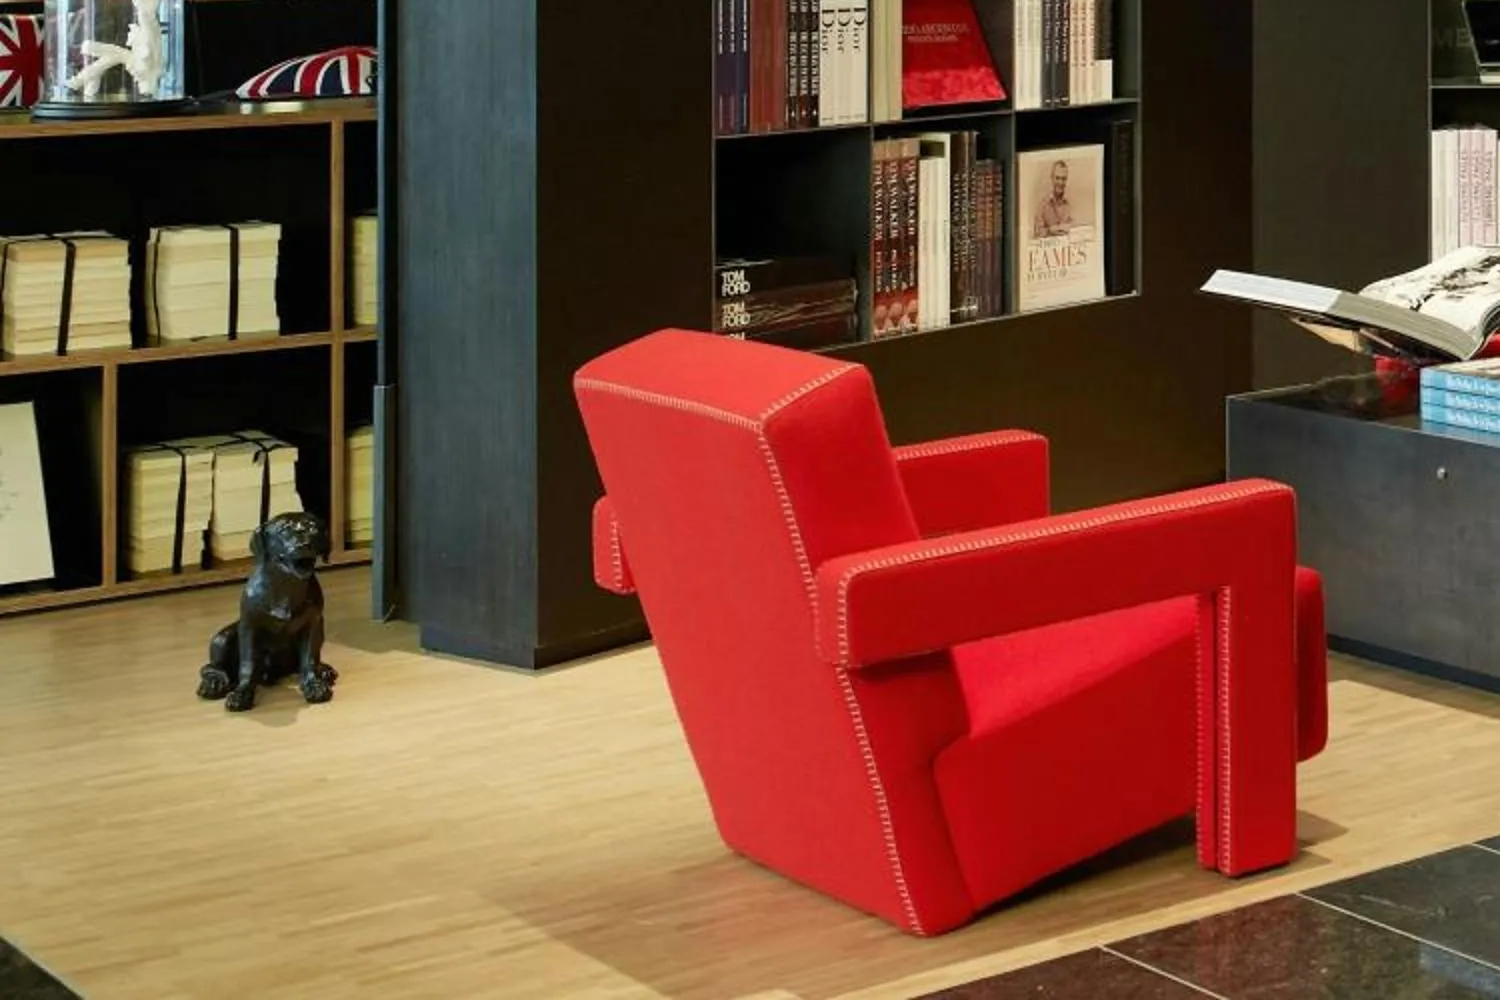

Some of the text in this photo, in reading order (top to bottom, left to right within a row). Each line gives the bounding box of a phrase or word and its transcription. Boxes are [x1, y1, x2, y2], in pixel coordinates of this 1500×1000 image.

[837, 8, 851, 54] Dior
[853, 7, 867, 52] Dior
[721, 270, 745, 284] TOM
[722, 280, 750, 297] FORD
[722, 300, 745, 315] TOM
[722, 312, 750, 328] FORD
